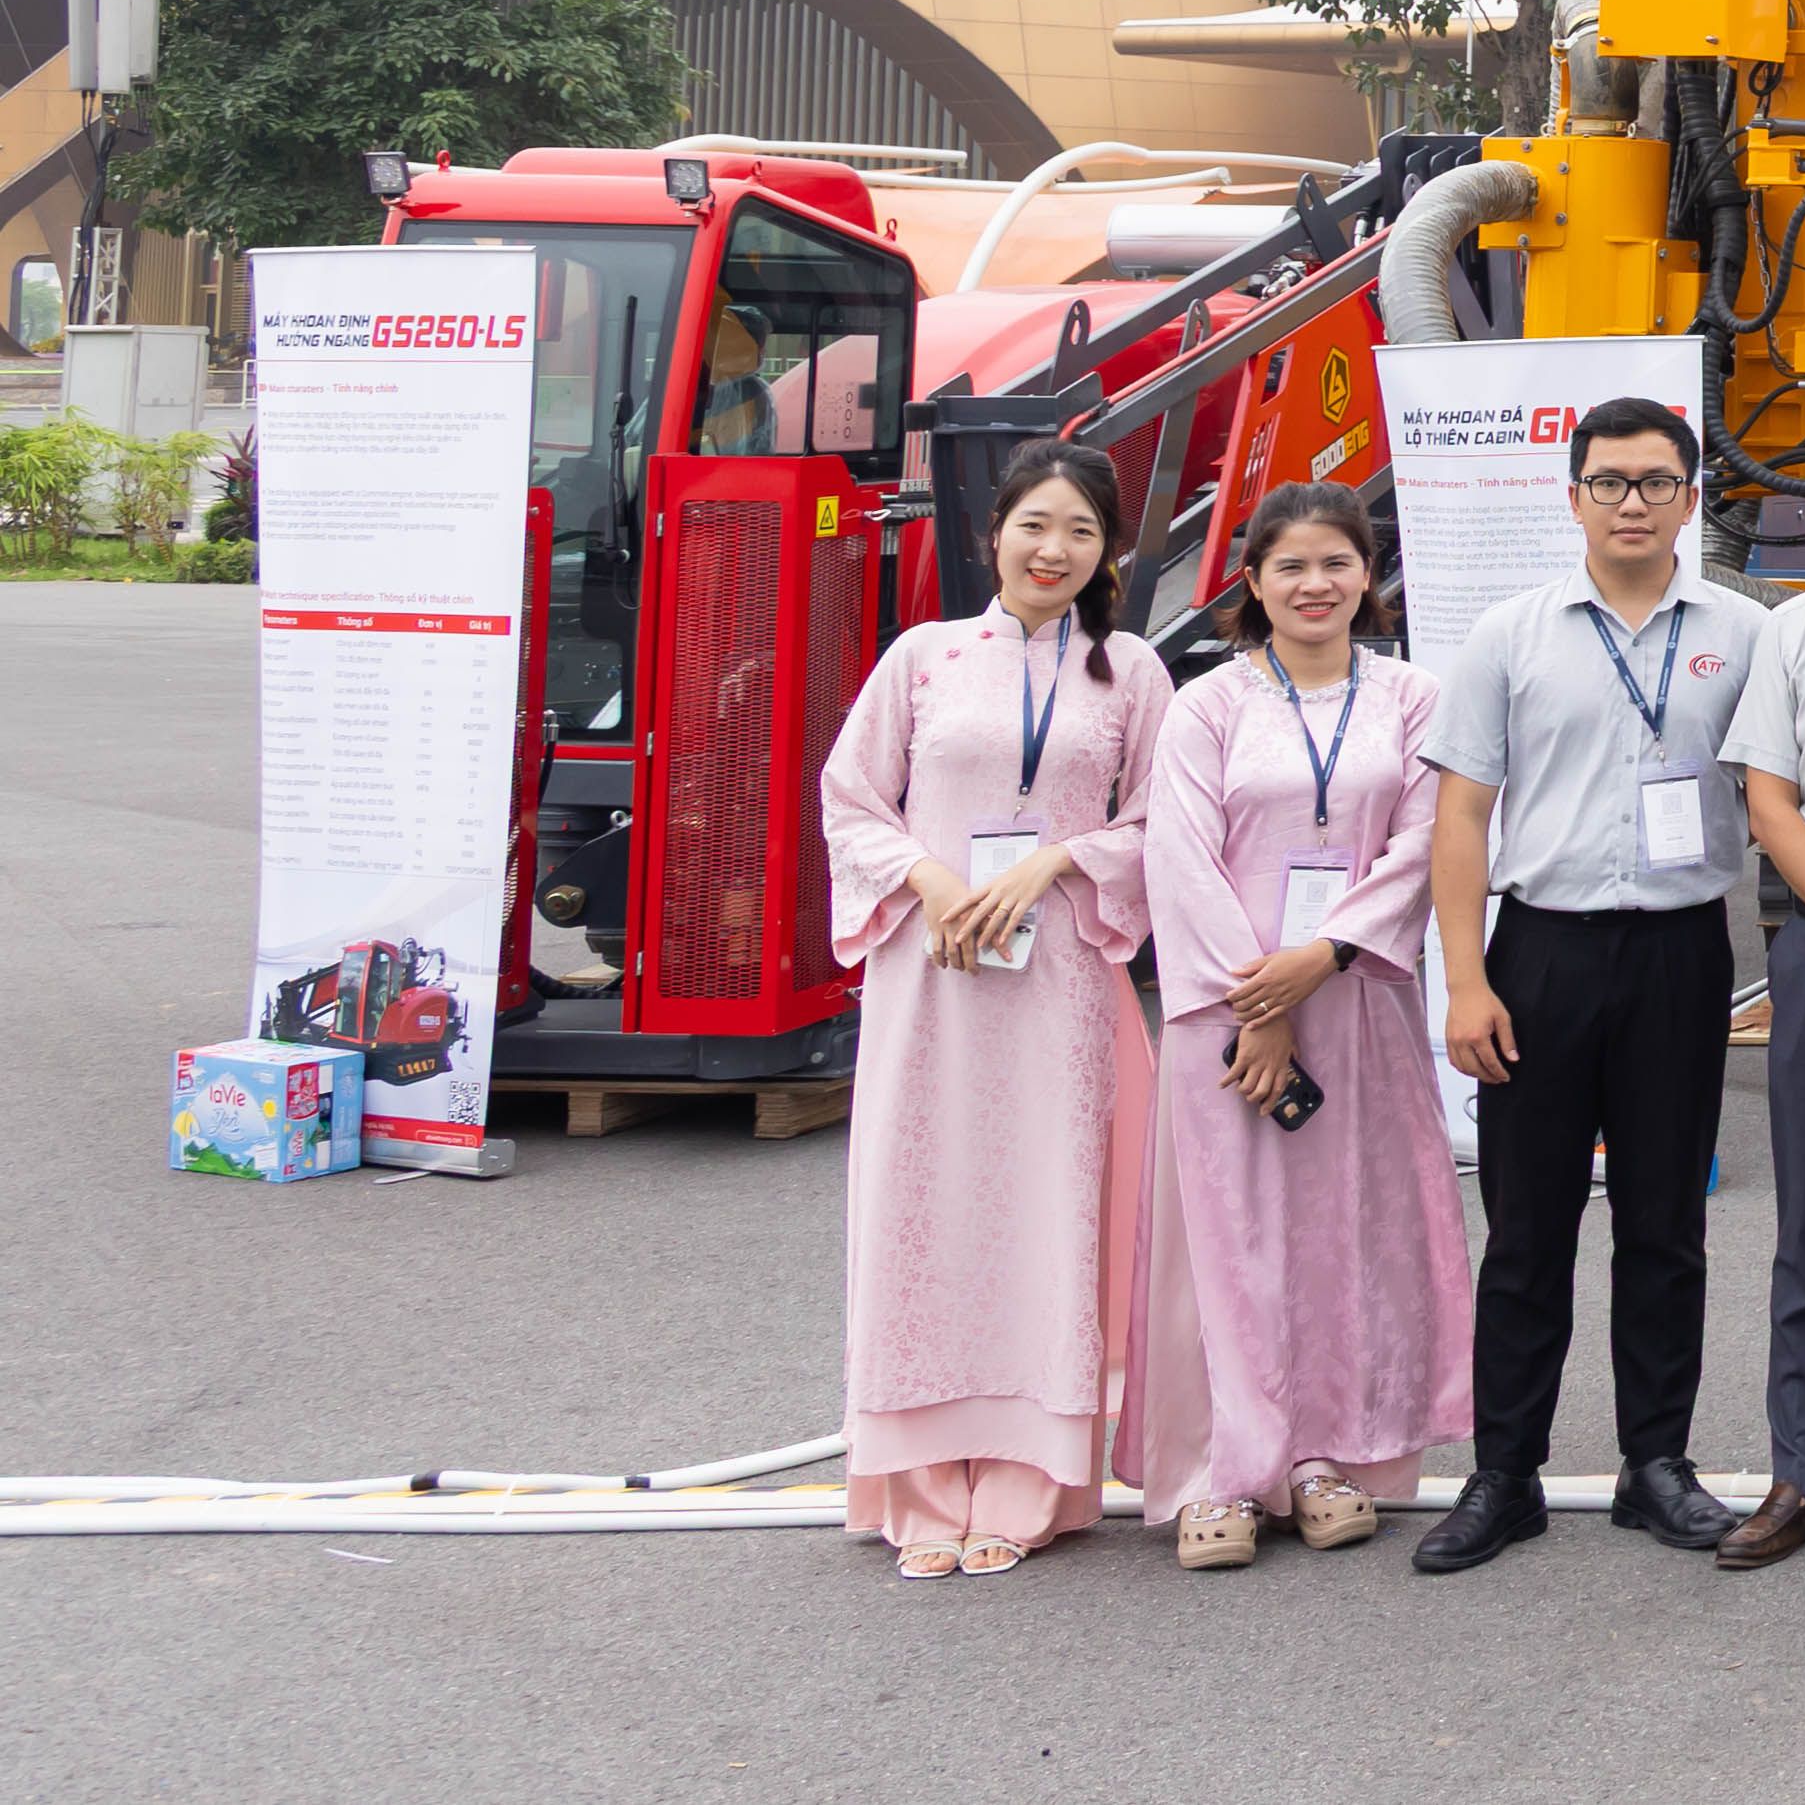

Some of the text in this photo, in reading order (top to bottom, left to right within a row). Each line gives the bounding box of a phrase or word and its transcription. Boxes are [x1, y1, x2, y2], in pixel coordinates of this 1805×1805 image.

[263, 312, 370, 331] MÁY KHOAN ĐỊNH
[276, 331, 370, 347] HƯỚNG NGANG
[371, 315, 527, 348] GS250-LS
[1404, 405, 1523, 424] MÁY KHOAN ĐÁ
[1405, 428, 1525, 448] LỘ THIÊN CABIN
[1477, 477, 1500, 487] Tính
[1697, 660, 1722, 675] ATI
